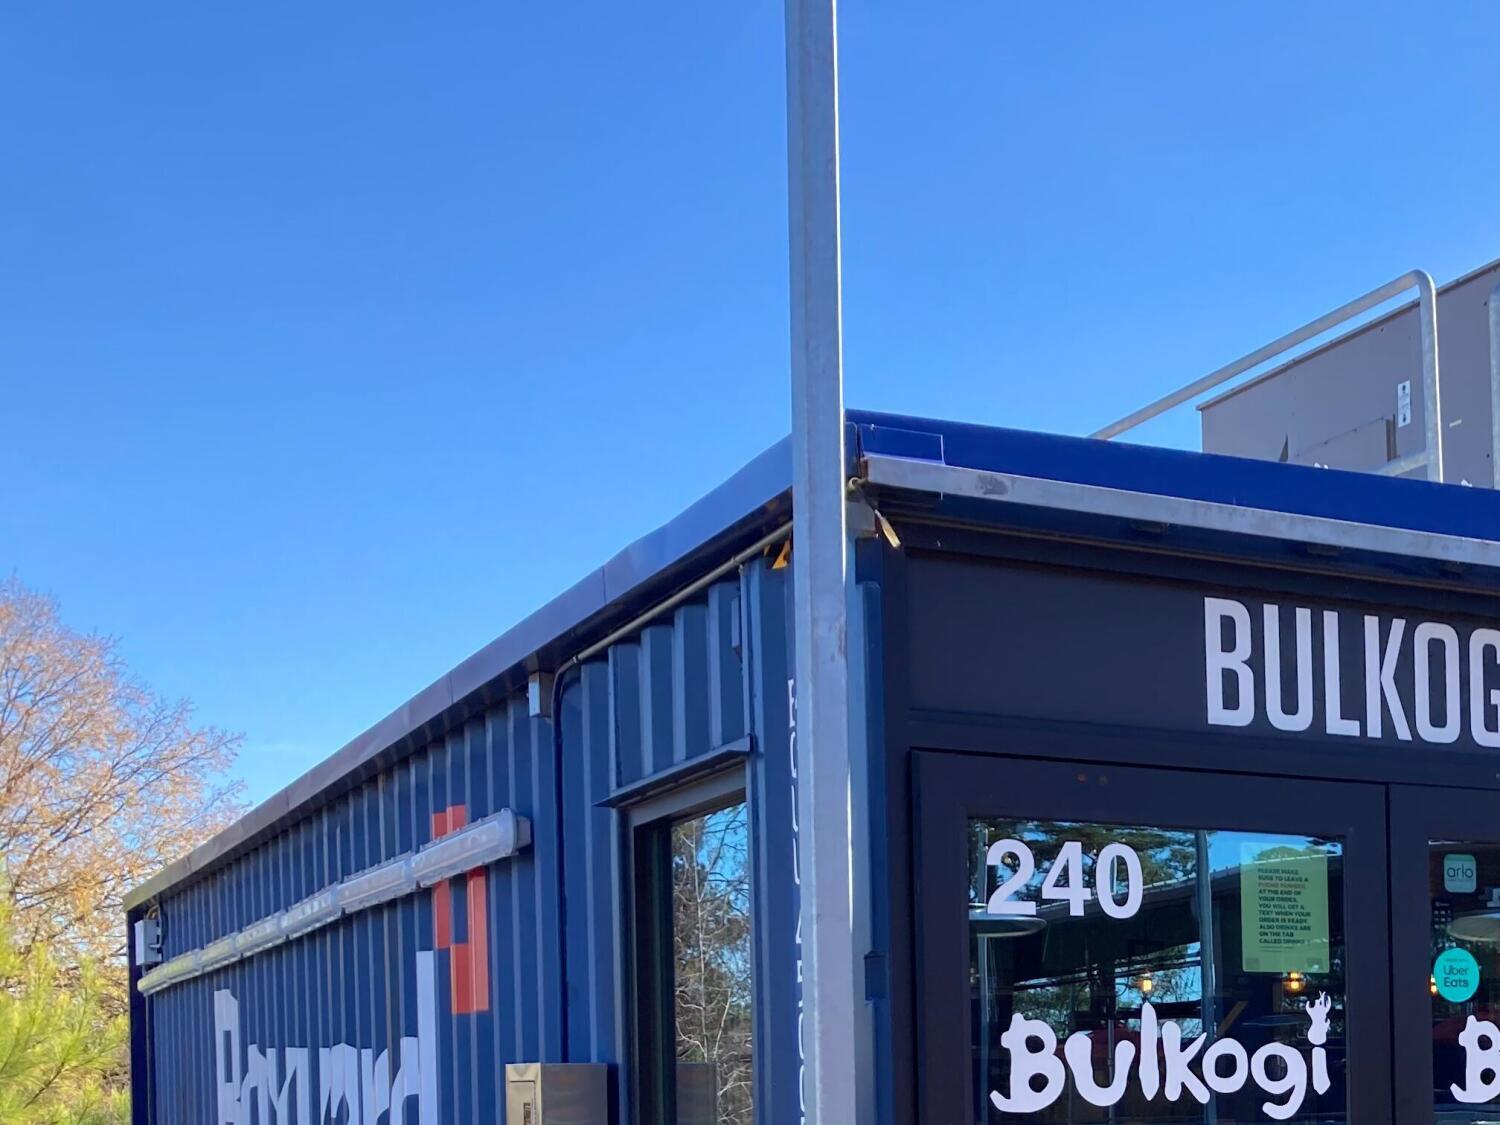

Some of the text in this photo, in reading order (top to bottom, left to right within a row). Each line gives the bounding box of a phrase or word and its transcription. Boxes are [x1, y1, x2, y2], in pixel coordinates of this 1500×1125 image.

[986, 838, 1144, 919] 240
[1446, 864, 1474, 879] arlo
[1443, 965, 1469, 976] Uber
[1443, 976, 1470, 988] Eats
[989, 990, 1332, 1120] Bulkogi
